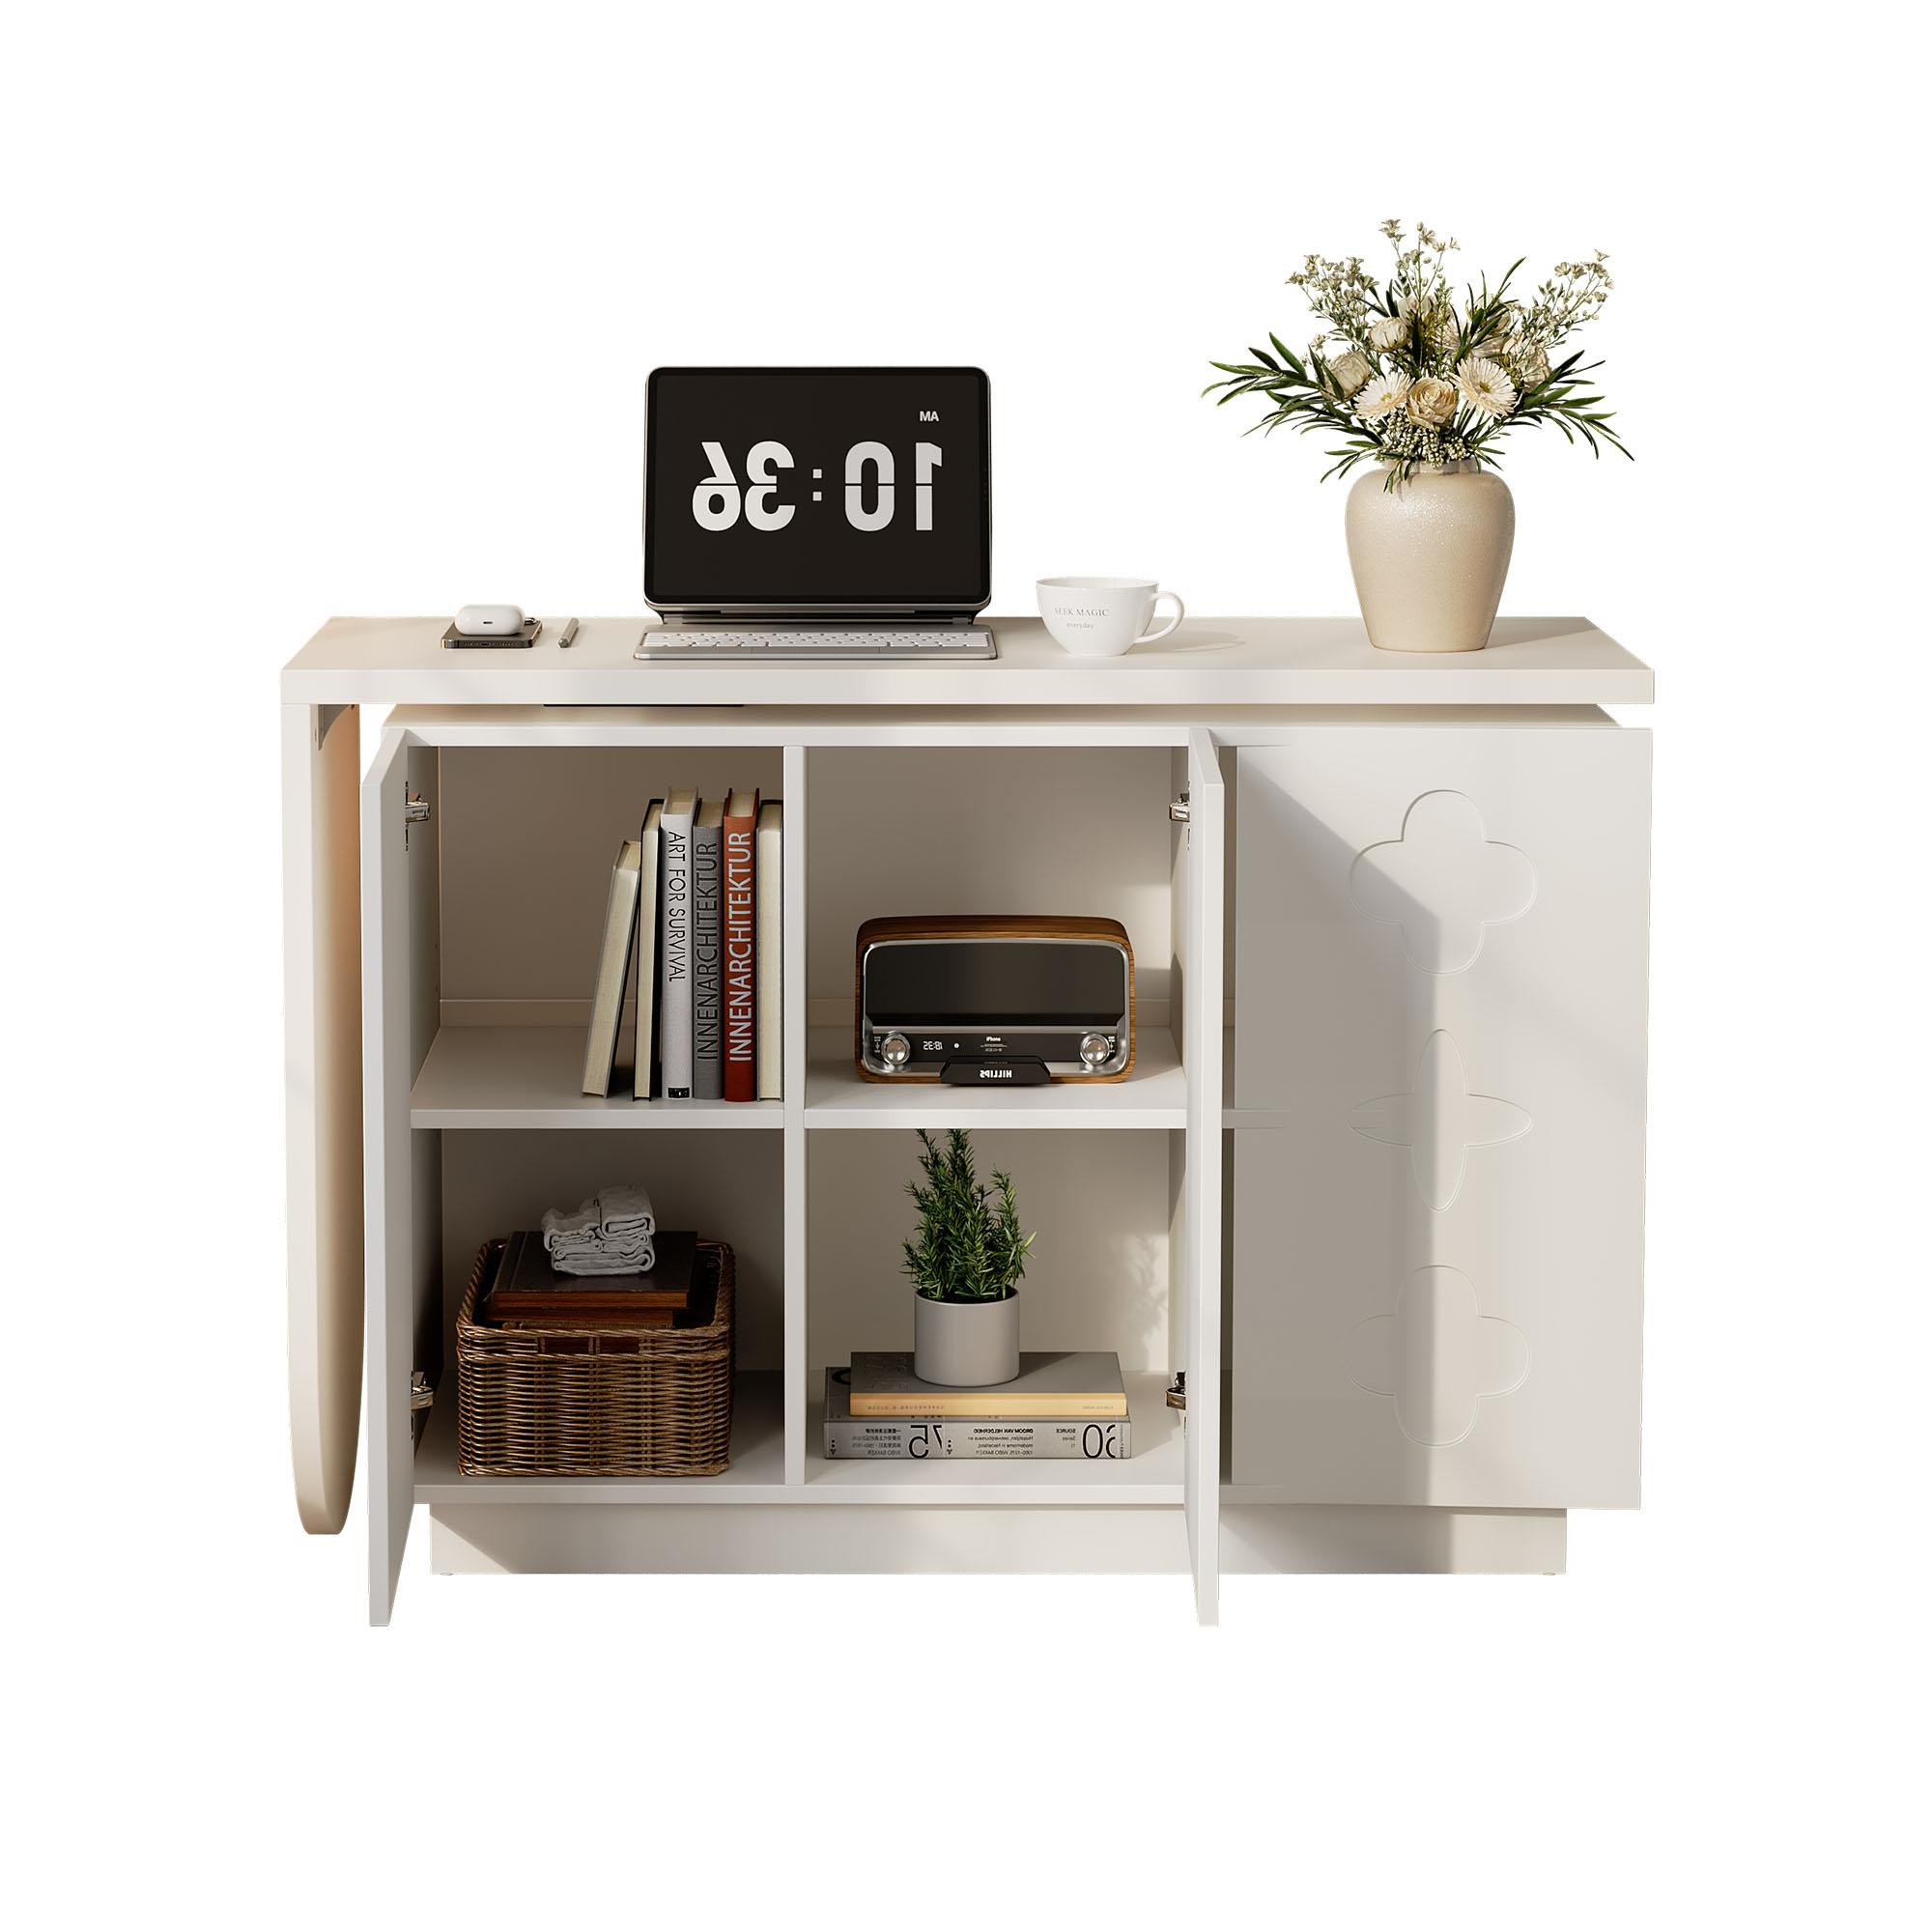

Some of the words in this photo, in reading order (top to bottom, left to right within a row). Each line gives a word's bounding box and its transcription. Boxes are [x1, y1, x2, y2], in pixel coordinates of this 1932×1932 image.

[1066, 621, 1094, 630] everyday
[1076, 608, 1110, 617] MAGIC
[668, 831, 687, 862] ART
[668, 868, 687, 902] FOR
[668, 907, 687, 982] SURVIVAL
[696, 841, 719, 1061] INNENARCHITEKTUR
[728, 832, 753, 1062] INNENARCHITEKTUR
